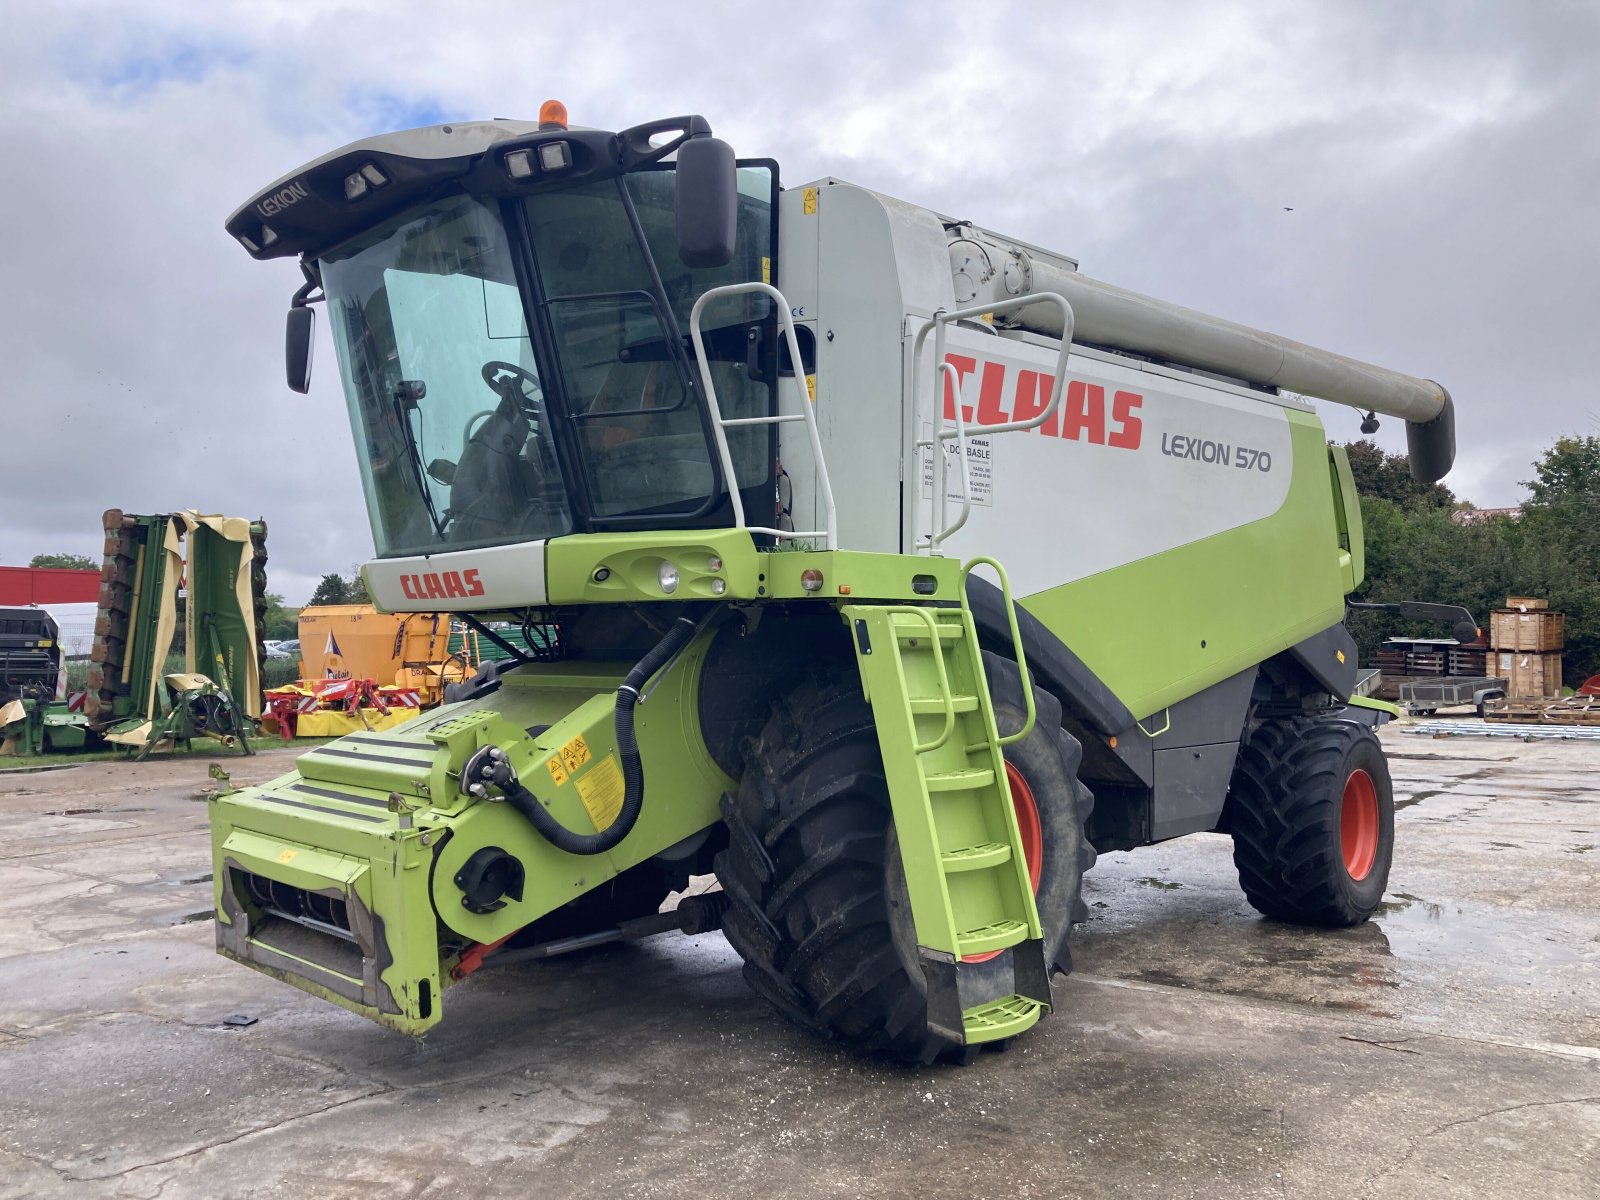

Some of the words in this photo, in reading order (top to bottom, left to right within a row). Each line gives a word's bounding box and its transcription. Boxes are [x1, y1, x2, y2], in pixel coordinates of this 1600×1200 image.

[256, 181, 309, 217] LEXION
[943, 352, 1144, 451] CLAAS
[949, 444, 991, 460] DOBASLE
[1161, 432, 1231, 466] LEXION
[1235, 446, 1272, 473] 570
[399, 568, 485, 600] CLAAS
